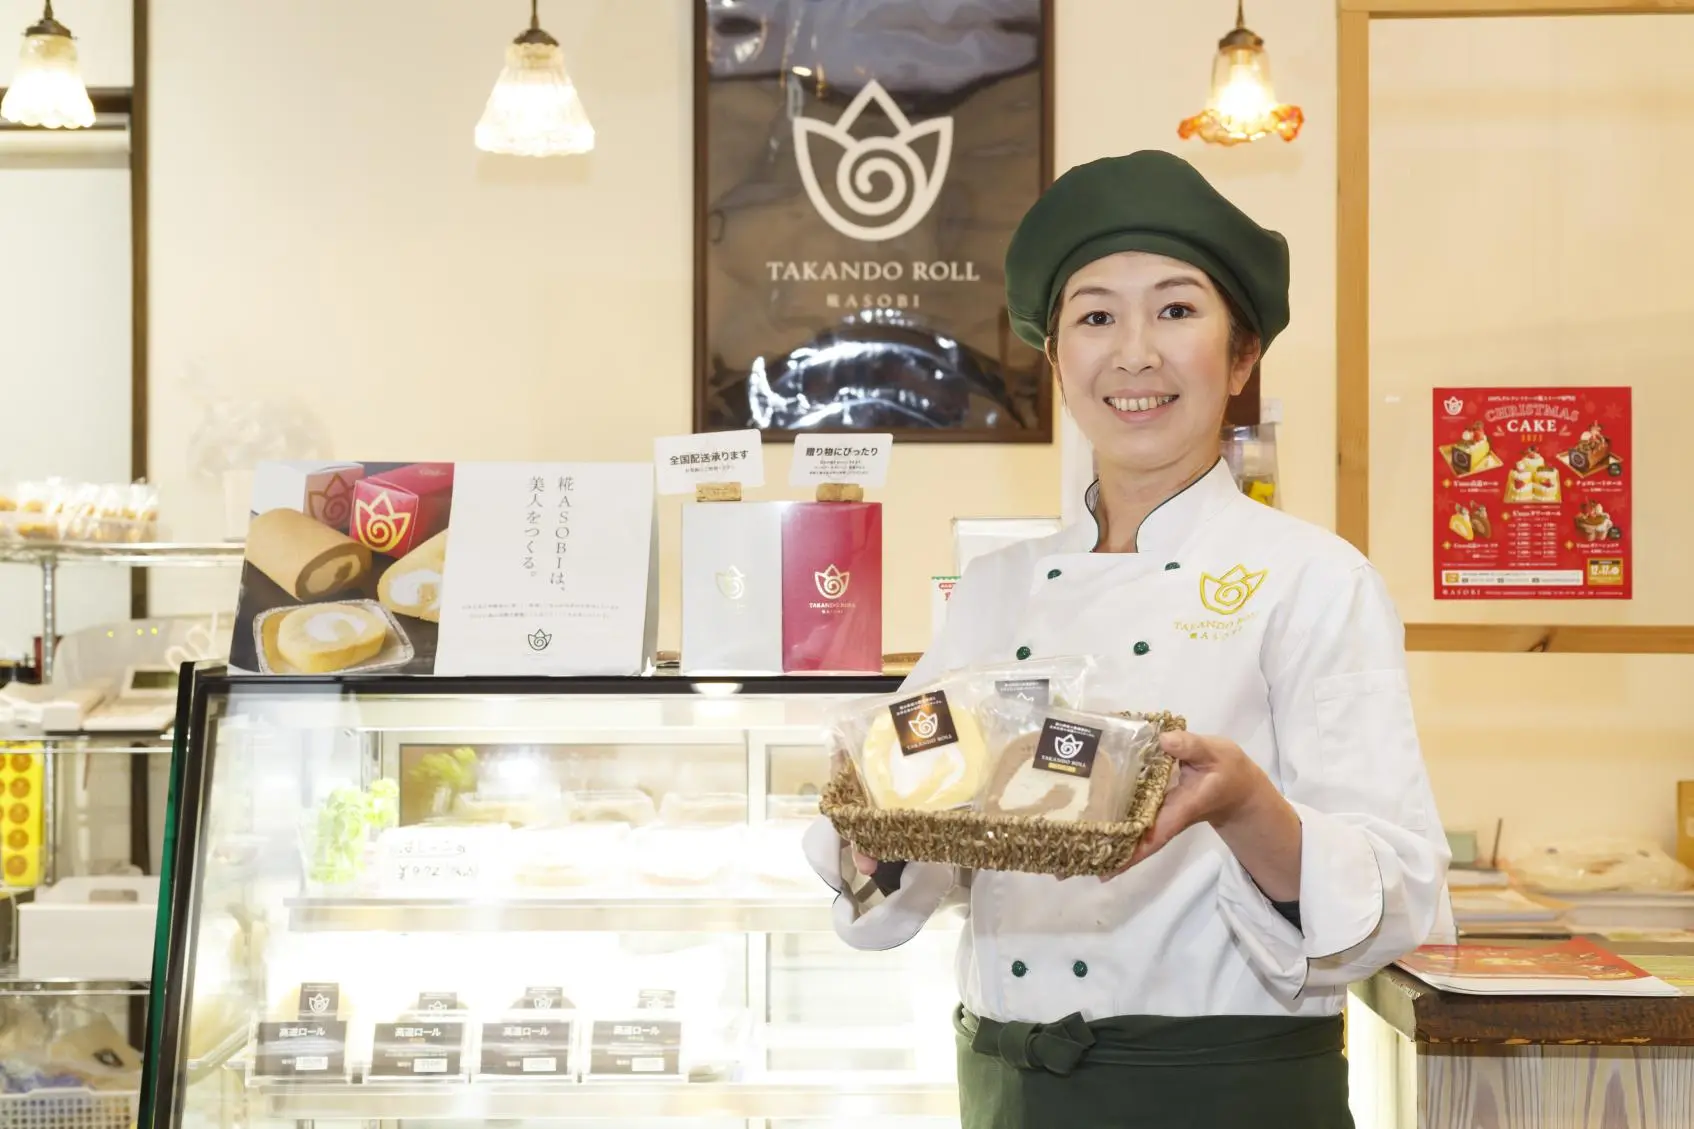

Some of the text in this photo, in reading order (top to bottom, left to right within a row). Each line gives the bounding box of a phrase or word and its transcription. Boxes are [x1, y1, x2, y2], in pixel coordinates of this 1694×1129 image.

[766, 261, 980, 281] TAKANDO ROLL
[1484, 403, 1580, 422] CHRISTMAS
[1506, 419, 1557, 433] CAKE
[669, 449, 749, 466] 全国配送承ります
[805, 447, 878, 456] 贈り物にぴったり
[522, 476, 545, 578] 美人をつくる。
